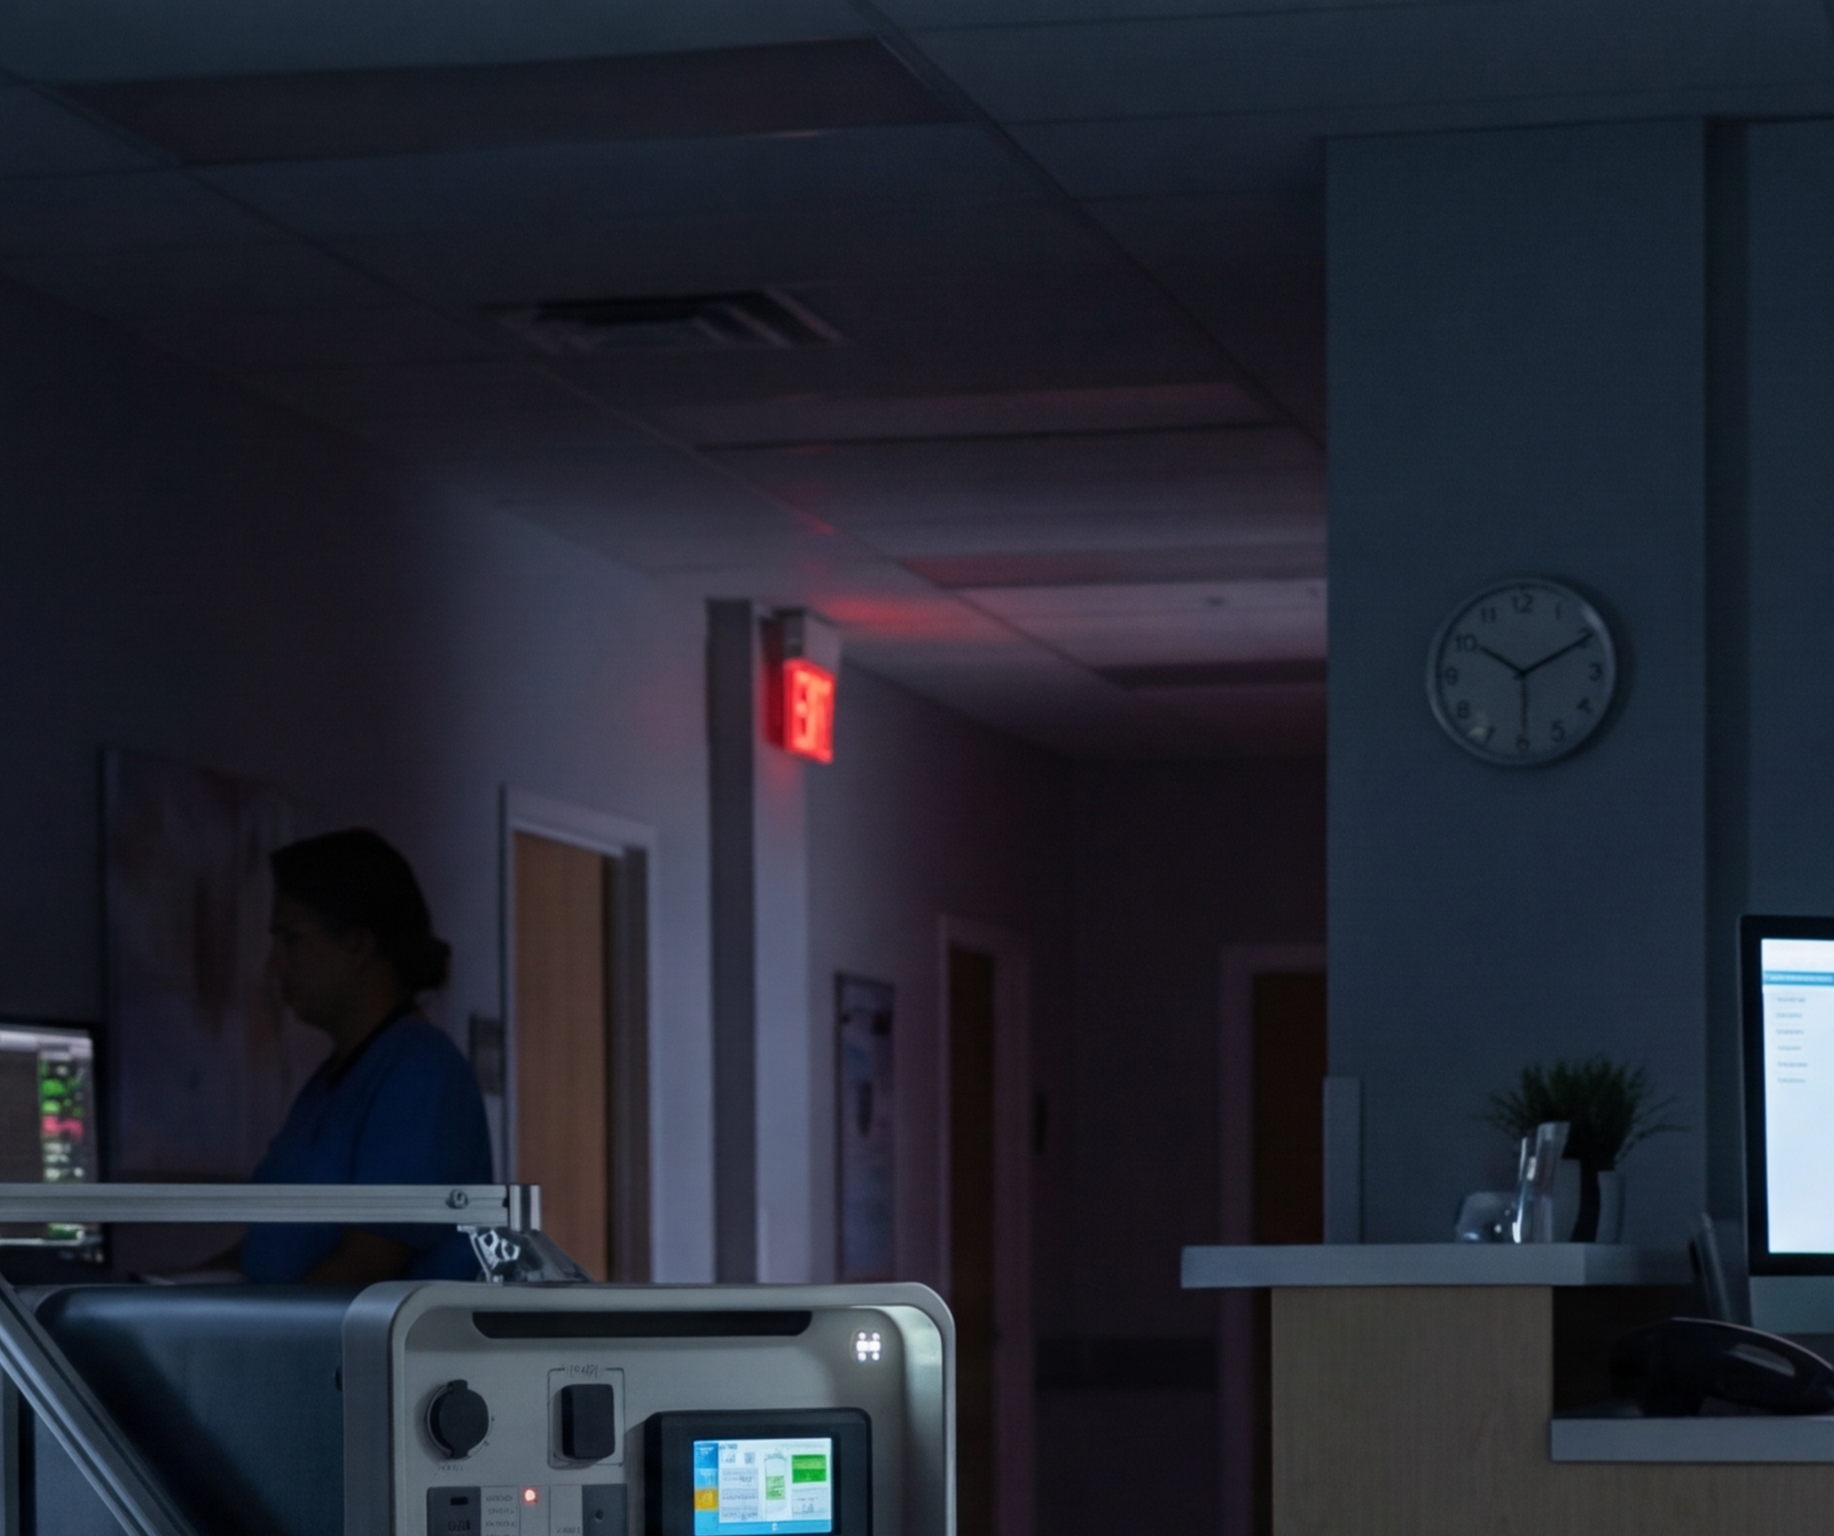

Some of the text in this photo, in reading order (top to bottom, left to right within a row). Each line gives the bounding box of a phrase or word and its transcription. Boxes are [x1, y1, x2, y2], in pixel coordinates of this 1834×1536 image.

[1511, 594, 1535, 613] 12
[1554, 603, 1562, 620] 1
[1480, 607, 1497, 623] 11
[1455, 634, 1478, 652] 10
[1444, 667, 1458, 685] 9
[1588, 663, 1603, 681] 3
[1550, 720, 1565, 742] 5
